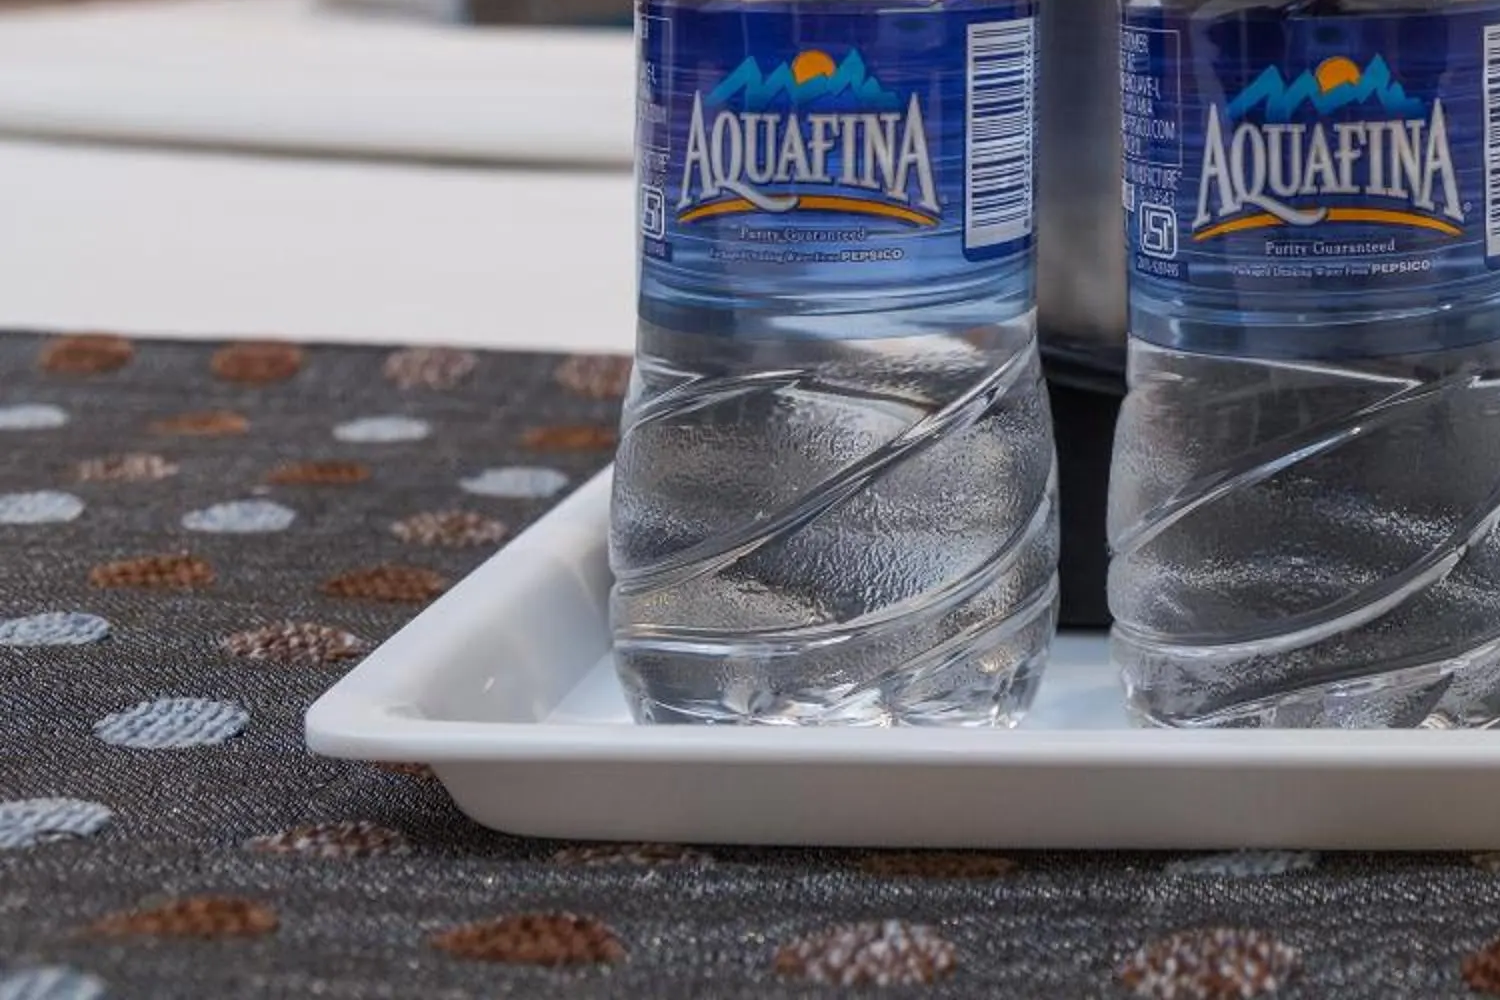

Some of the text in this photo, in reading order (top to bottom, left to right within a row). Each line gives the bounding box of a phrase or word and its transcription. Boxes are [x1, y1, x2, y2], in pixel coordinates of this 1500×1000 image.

[678, 89, 943, 214] AQUAFINA
[1191, 98, 1466, 229] AQUAFINA
[841, 249, 903, 262] PEPSICO
[1264, 239, 1396, 257] Purity Guaranteed
[1371, 258, 1431, 274] PEPSICO
